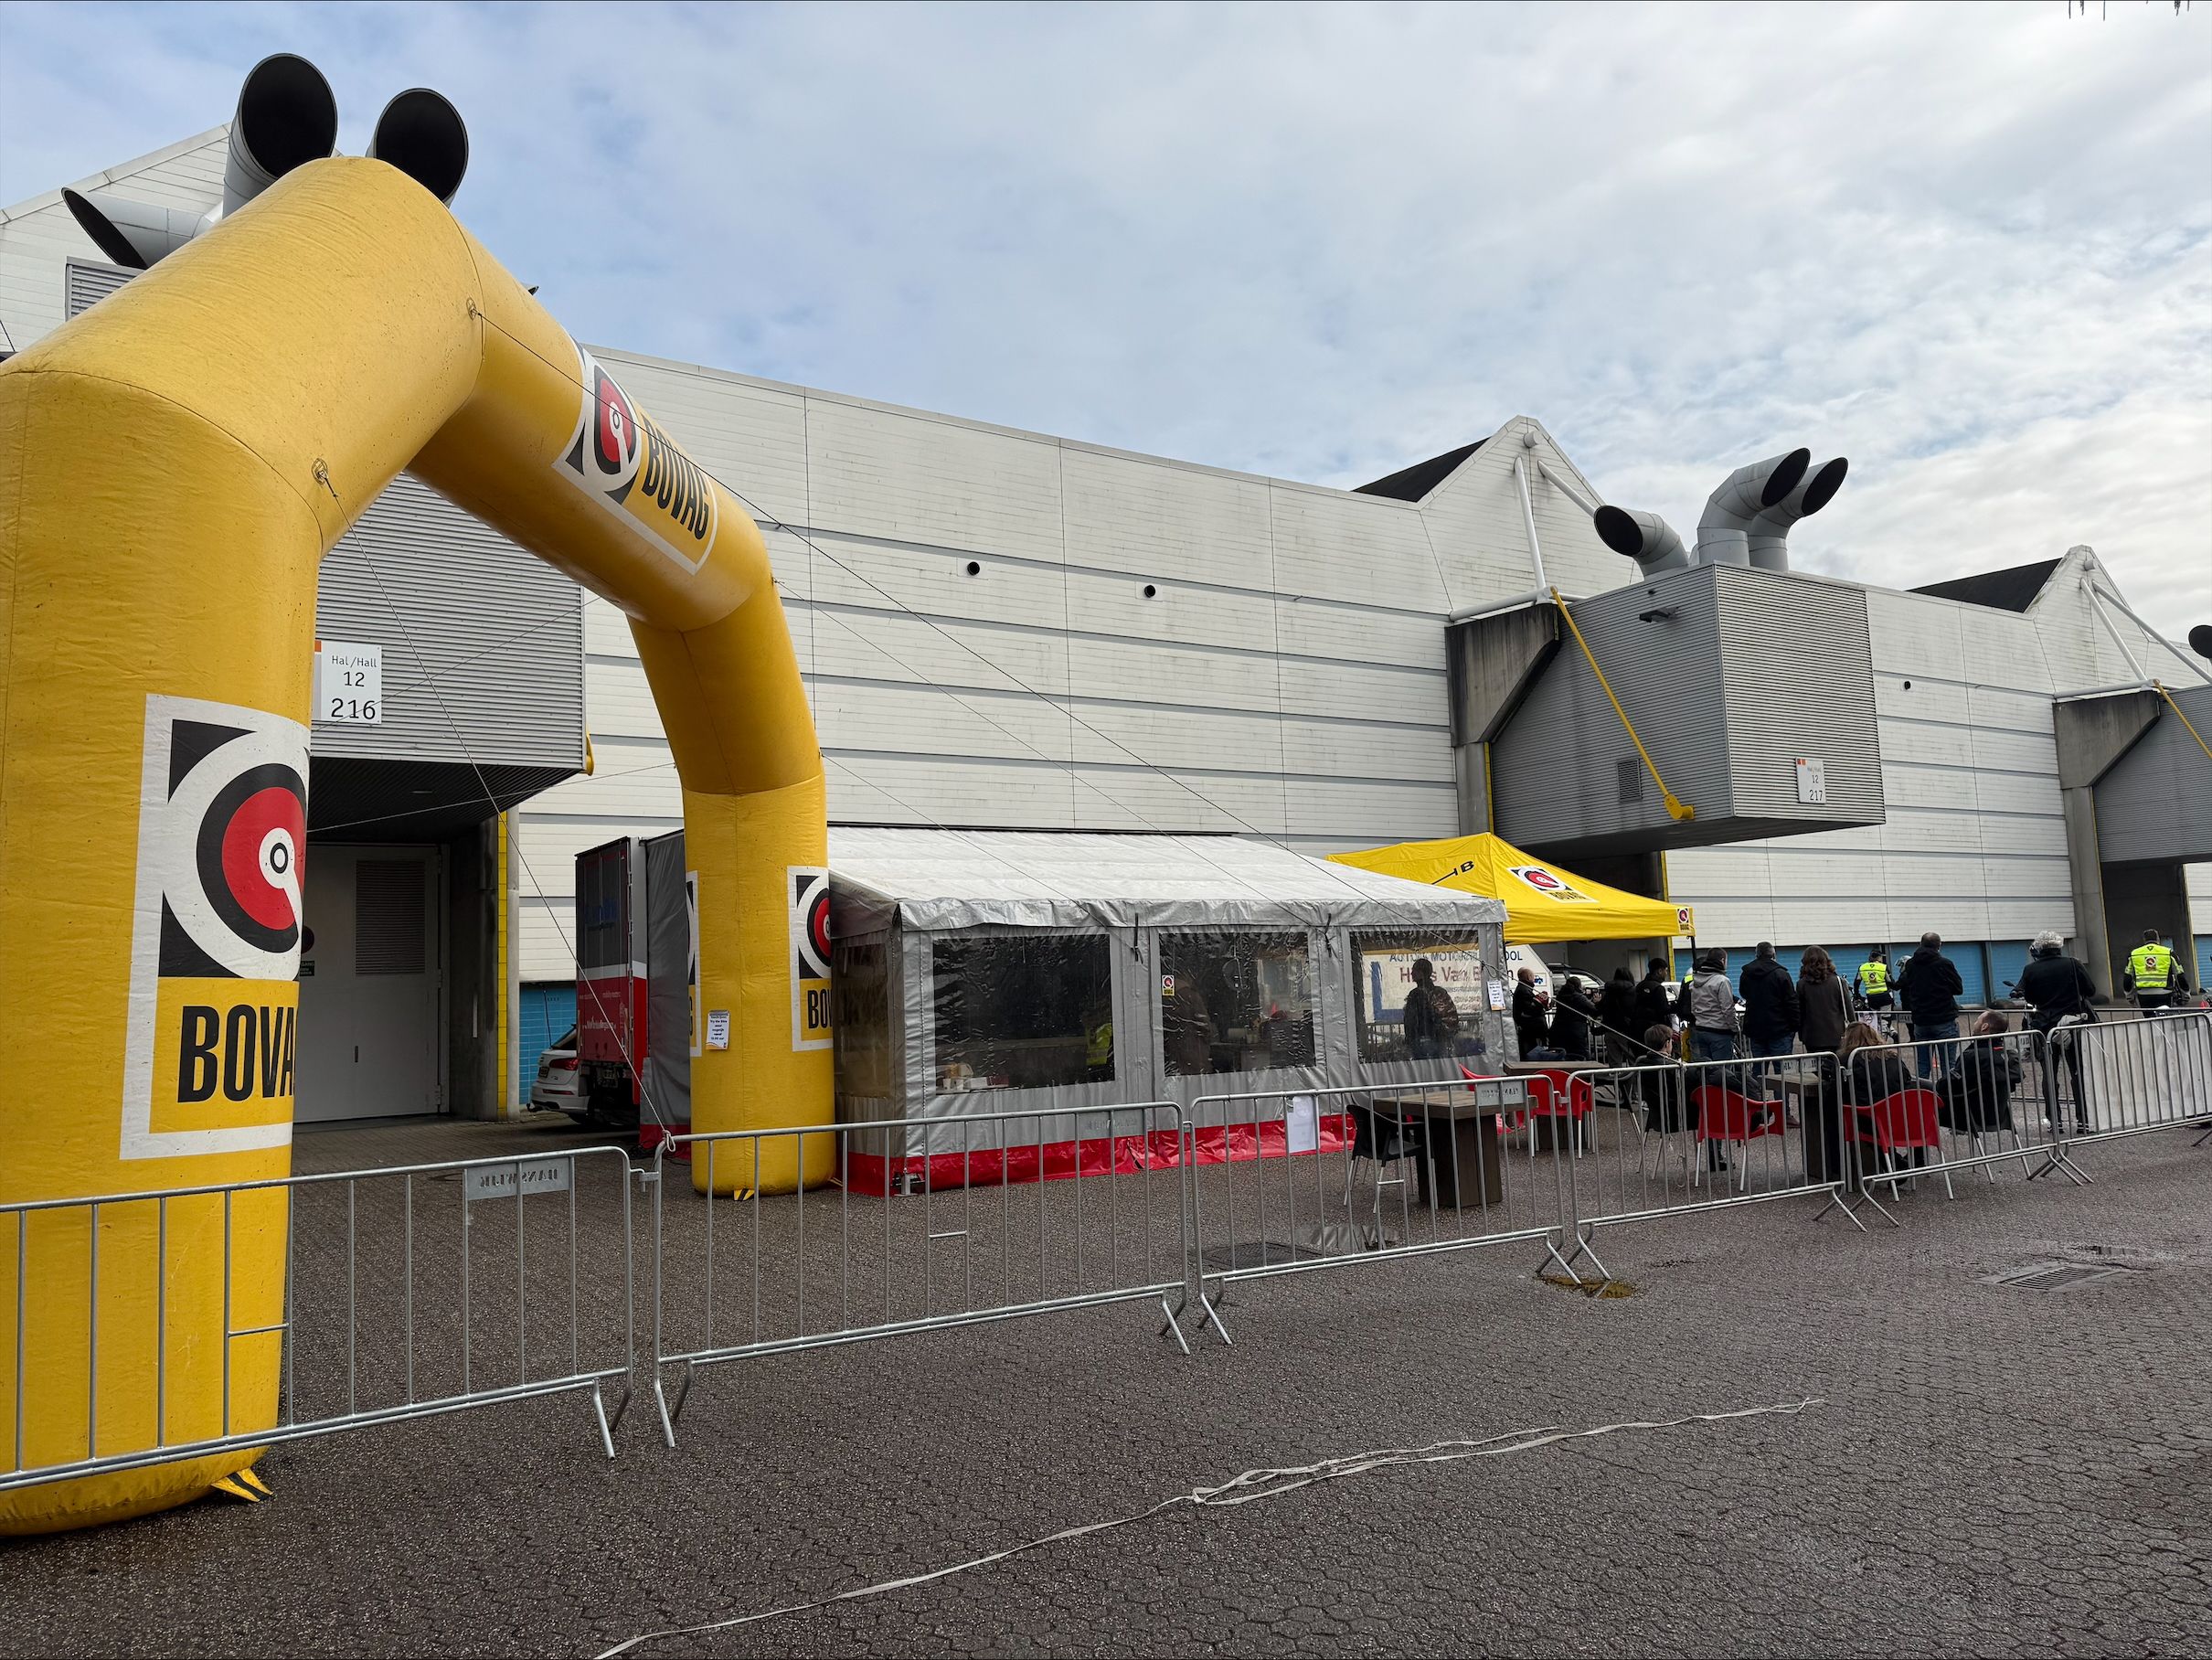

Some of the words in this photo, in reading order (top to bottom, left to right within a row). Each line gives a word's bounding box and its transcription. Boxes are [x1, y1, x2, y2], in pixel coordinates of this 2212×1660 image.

[641, 414, 709, 540] BOVAG
[344, 671, 365, 687] 12
[331, 697, 377, 720] 216
[1809, 789, 1823, 801] 217
[177, 1004, 295, 1103] BOVA
